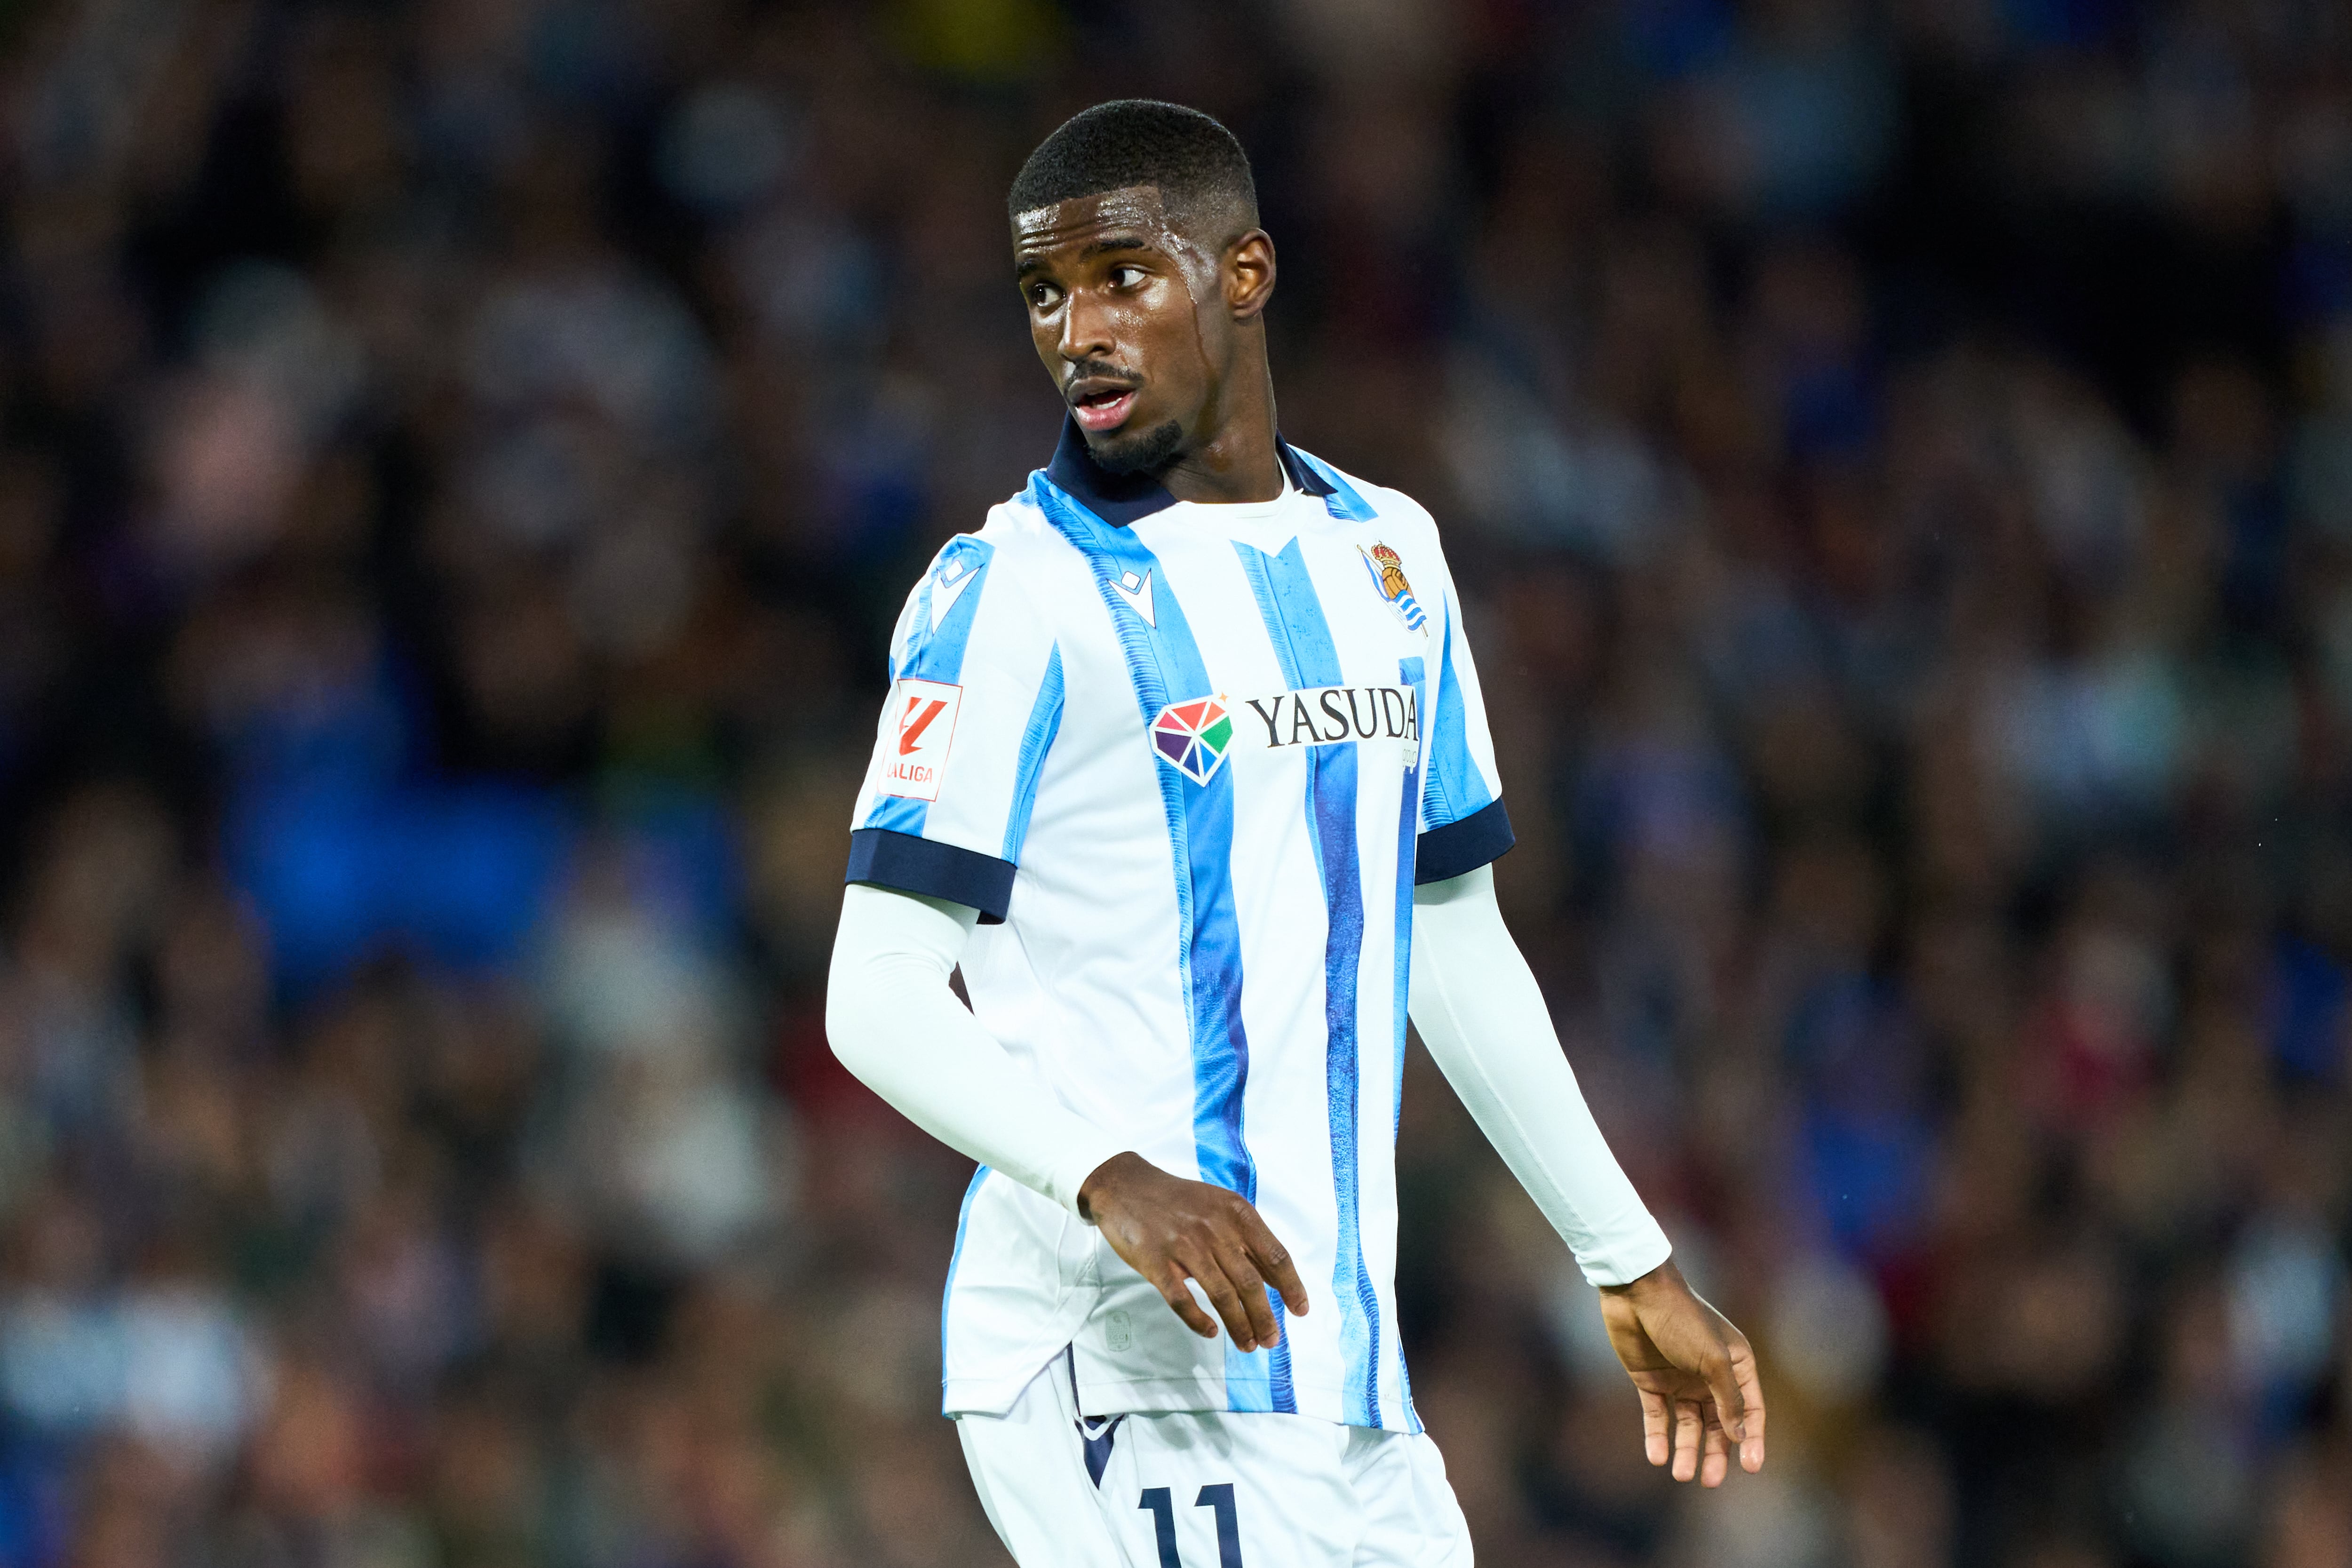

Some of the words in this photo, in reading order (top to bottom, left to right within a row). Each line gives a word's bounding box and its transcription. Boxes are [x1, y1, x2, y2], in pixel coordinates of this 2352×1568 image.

[1245, 688, 1418, 748] YASUDA
[887, 762, 933, 783] LALIGA
[1137, 1483, 1243, 1568] 11
